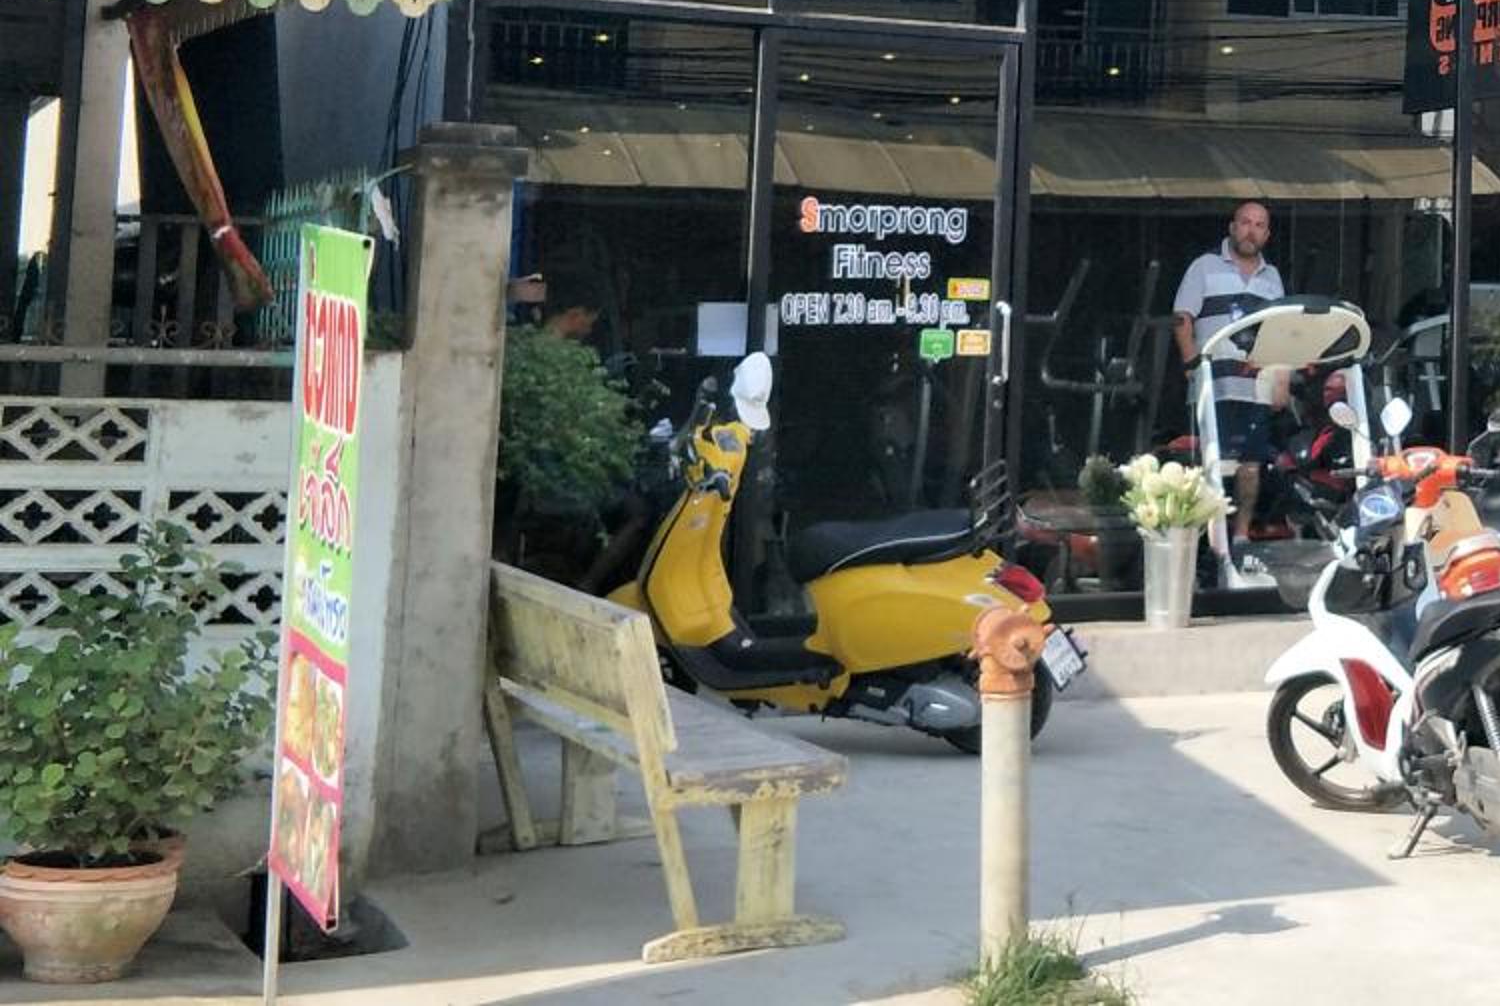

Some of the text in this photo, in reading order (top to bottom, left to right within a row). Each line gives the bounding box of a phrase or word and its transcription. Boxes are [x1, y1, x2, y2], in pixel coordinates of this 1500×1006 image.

[800, 196, 968, 244] Smorprong
[832, 244, 931, 279] Fitness
[781, 293, 829, 325] OPEN
